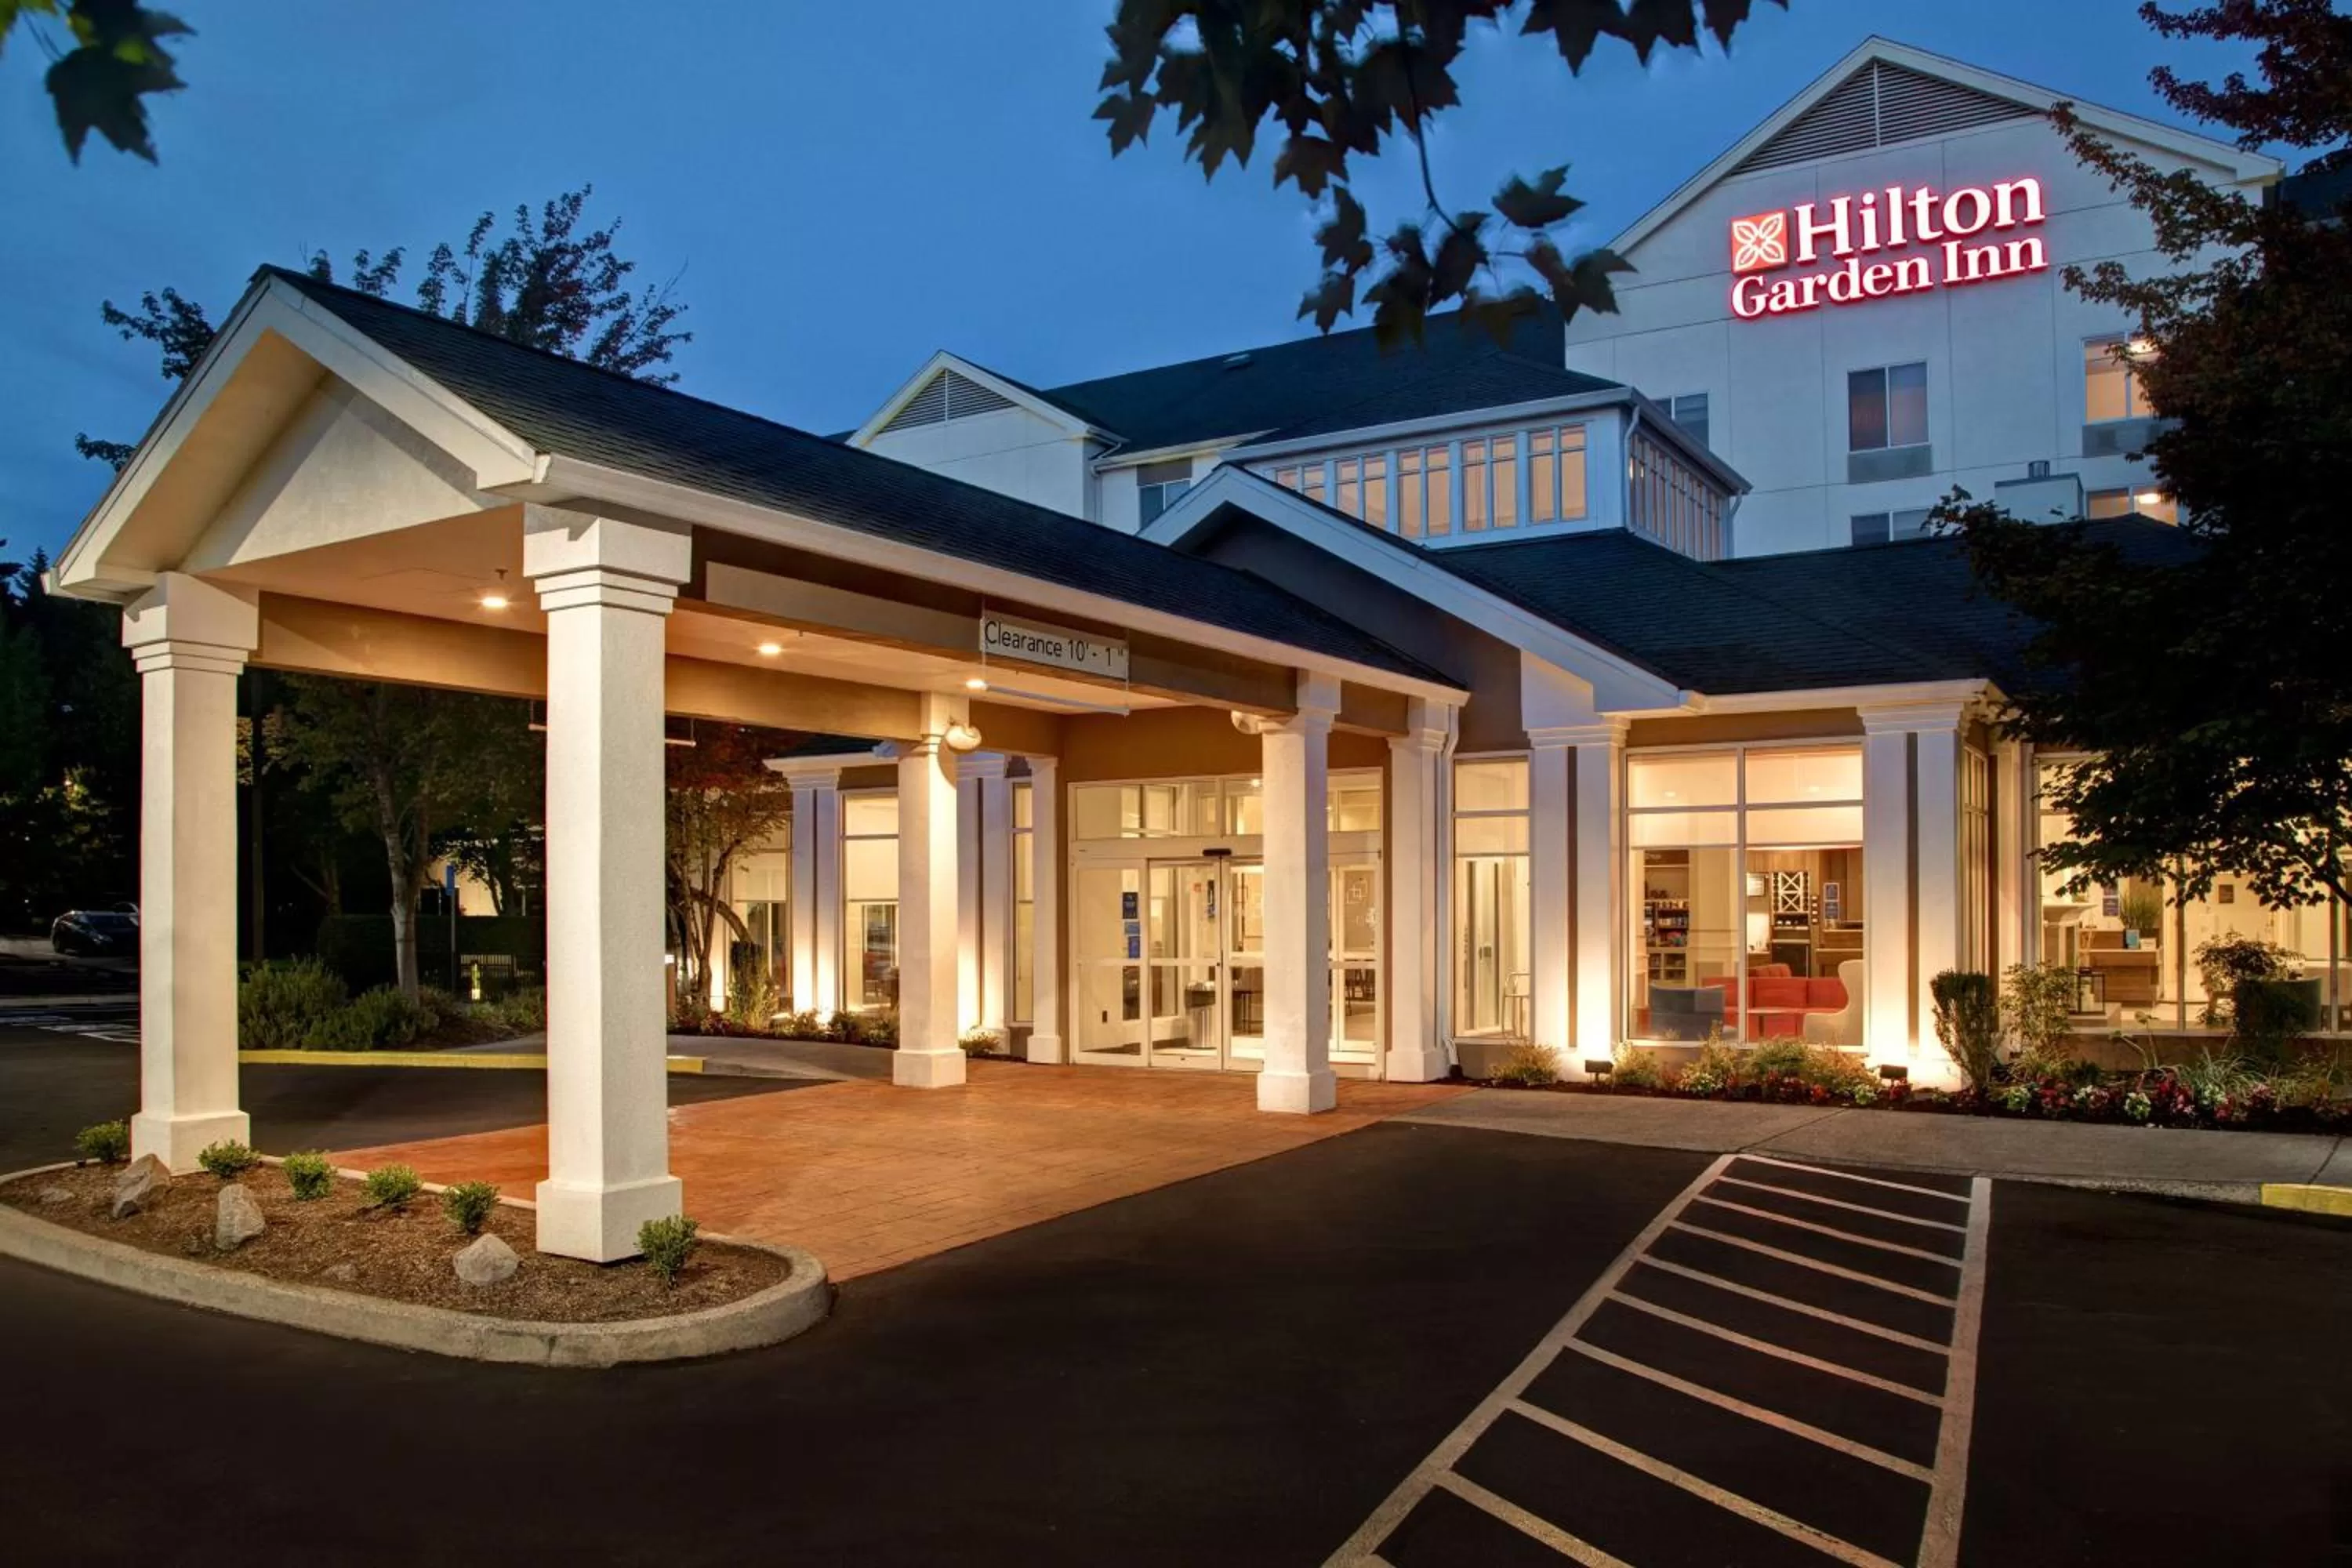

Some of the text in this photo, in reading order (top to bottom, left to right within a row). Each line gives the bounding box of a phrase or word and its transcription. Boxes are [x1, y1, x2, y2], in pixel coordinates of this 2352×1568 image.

[1794, 176, 2045, 262] Hilton
[1732, 236, 2049, 317] Garden Inn
[984, 621, 1062, 657] Clearance
